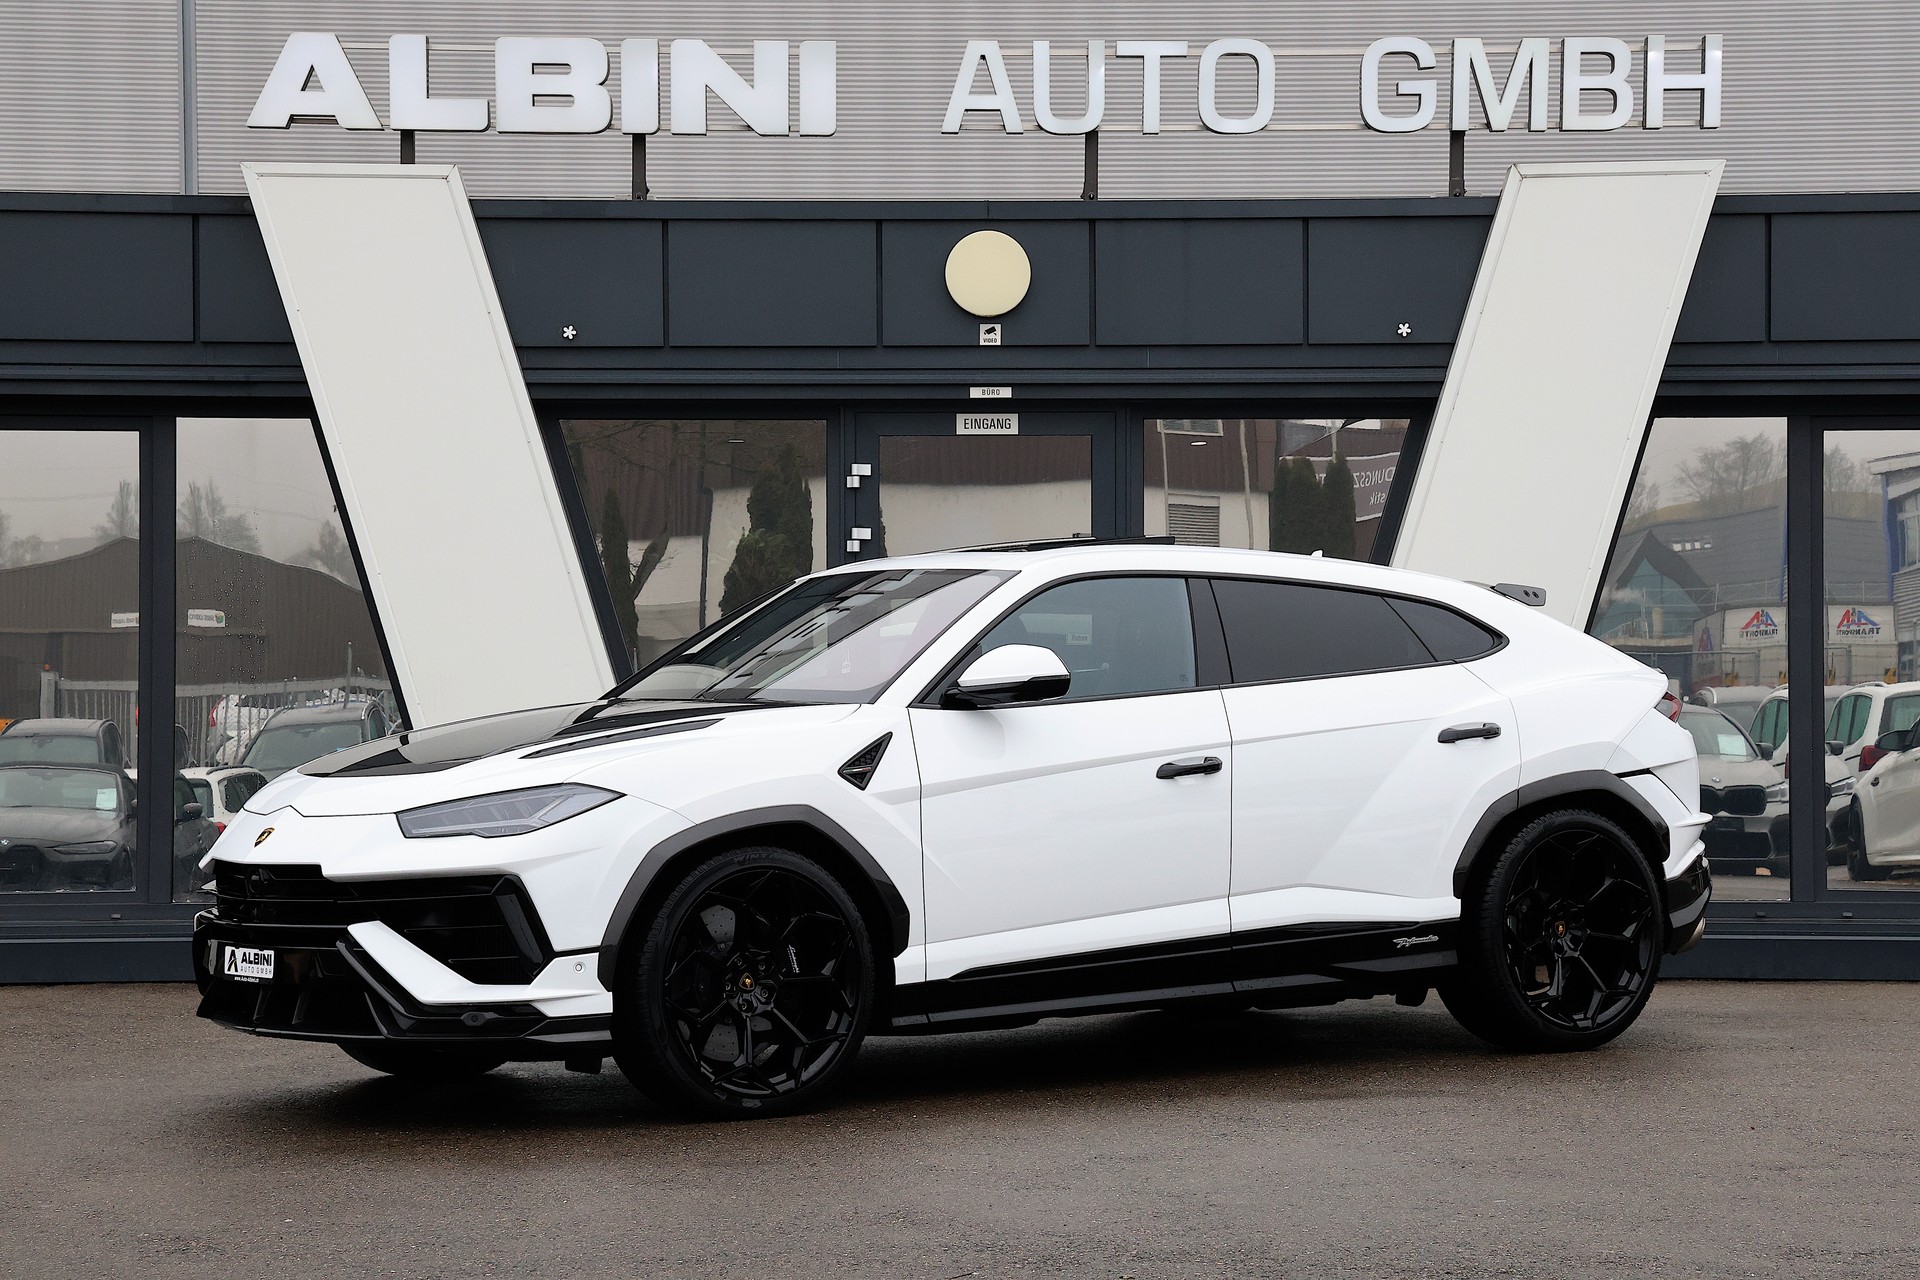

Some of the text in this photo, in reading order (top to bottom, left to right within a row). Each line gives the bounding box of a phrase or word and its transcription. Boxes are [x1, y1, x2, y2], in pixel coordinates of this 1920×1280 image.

[247, 32, 1724, 137] ALBINI AUTO GMBH
[981, 387, 1001, 396] BÜRO
[963, 418, 1012, 430] EINGANG
[241, 951, 272, 966] ALBINI
[256, 966, 272, 975] GMBH
